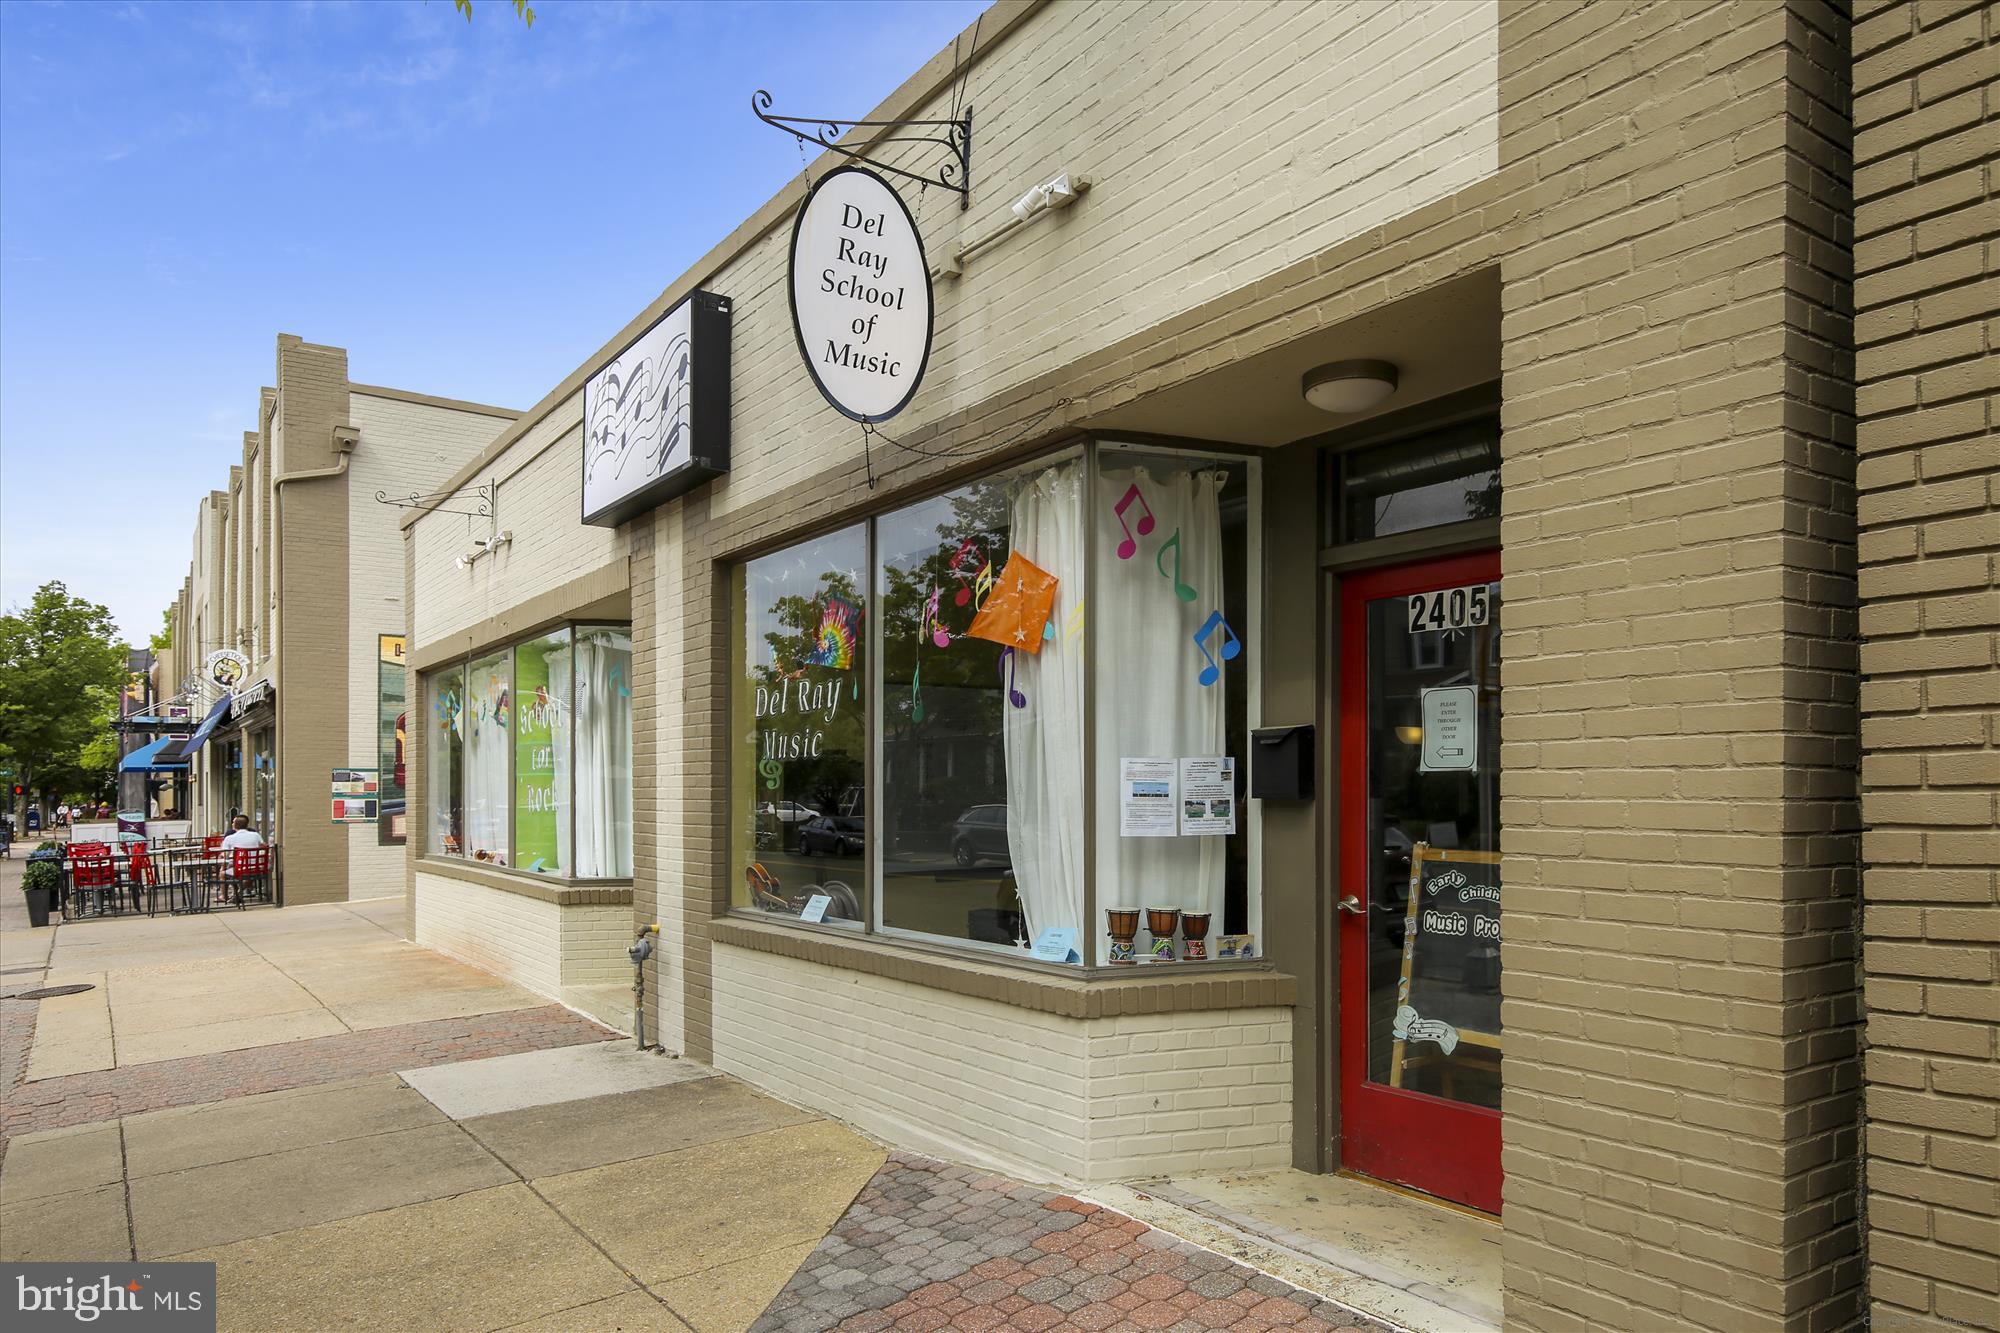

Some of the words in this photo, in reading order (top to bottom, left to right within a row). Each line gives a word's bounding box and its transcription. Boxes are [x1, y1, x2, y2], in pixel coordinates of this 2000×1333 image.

[841, 203, 885, 237] Del
[836, 236, 888, 278] Ray
[820, 268, 904, 310] School
[851, 314, 878, 344] of
[823, 339, 901, 377] Music
[1410, 586, 1487, 632] 2405
[755, 677, 789, 717] Del
[798, 678, 842, 722] Ray
[763, 728, 823, 760] Music
[1427, 870, 1466, 895] Early
[1460, 886, 1500, 901] Childh
[1425, 911, 1467, 935] Music
[1475, 916, 1500, 938] Pro
